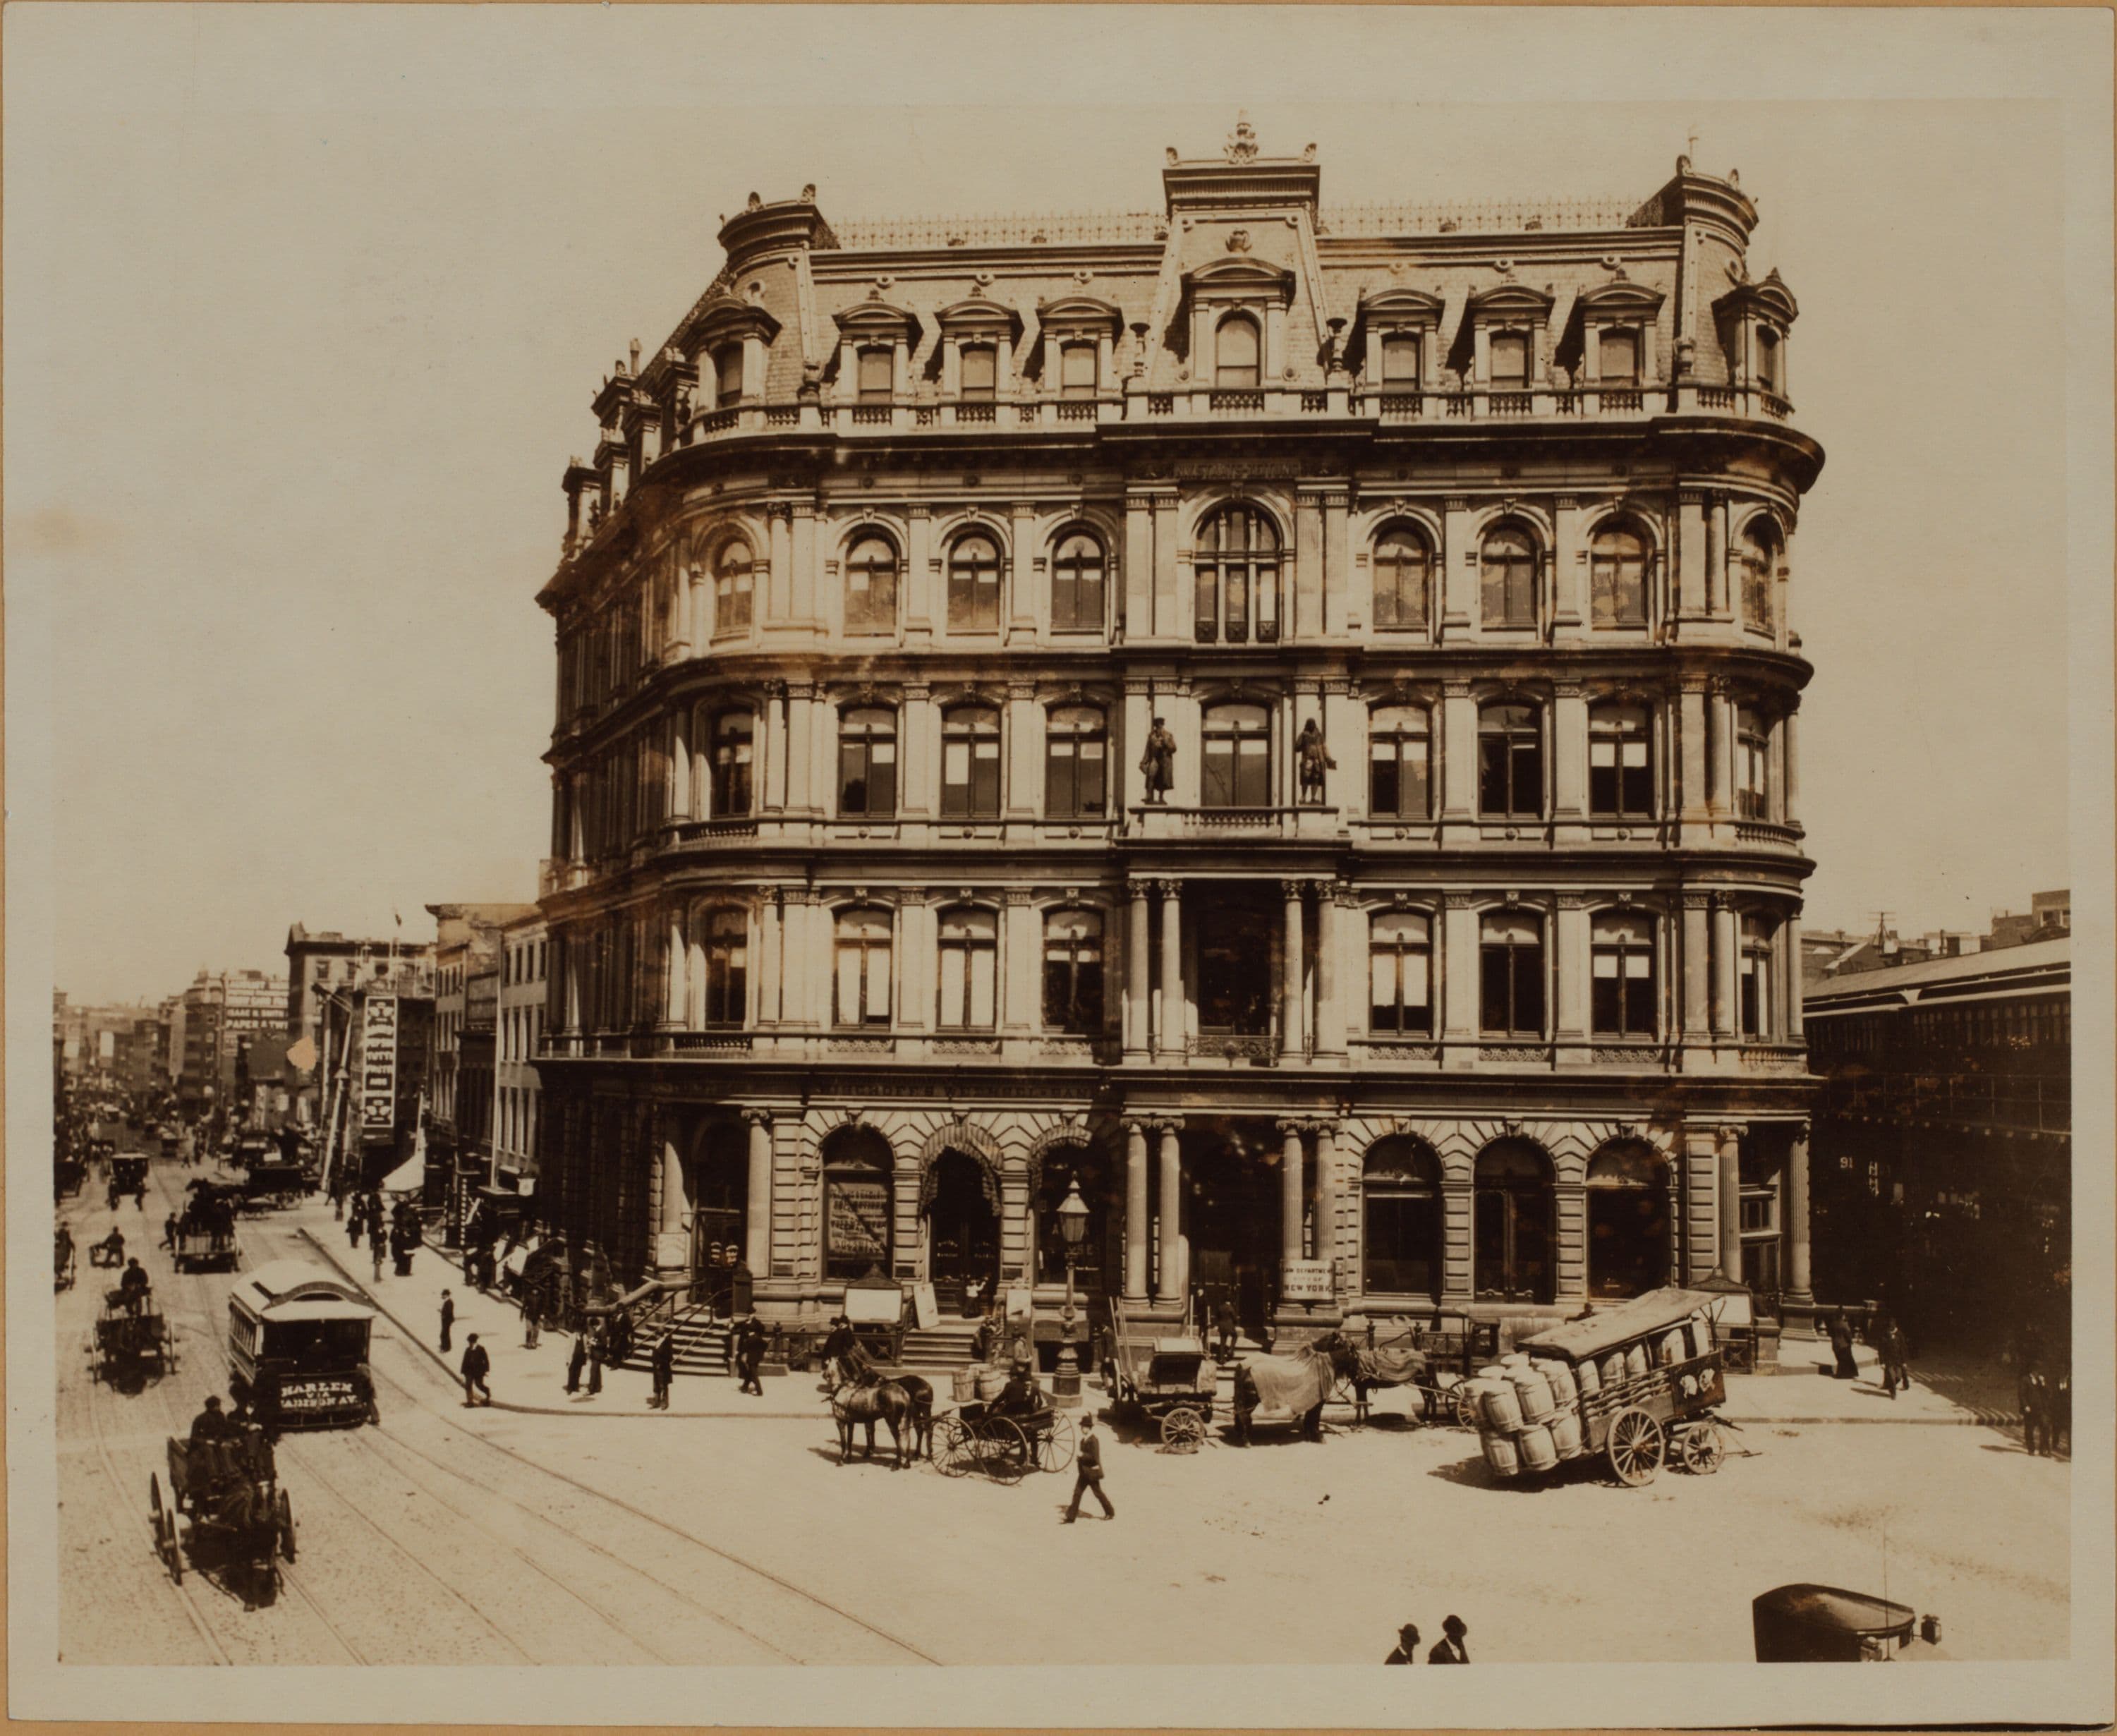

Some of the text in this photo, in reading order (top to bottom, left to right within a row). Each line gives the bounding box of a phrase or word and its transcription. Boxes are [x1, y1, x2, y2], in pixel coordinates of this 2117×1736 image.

[1839, 1156, 1853, 1169] 91
[1283, 1284, 1304, 1292] NEW
[281, 1382, 353, 1397] HARLEM
